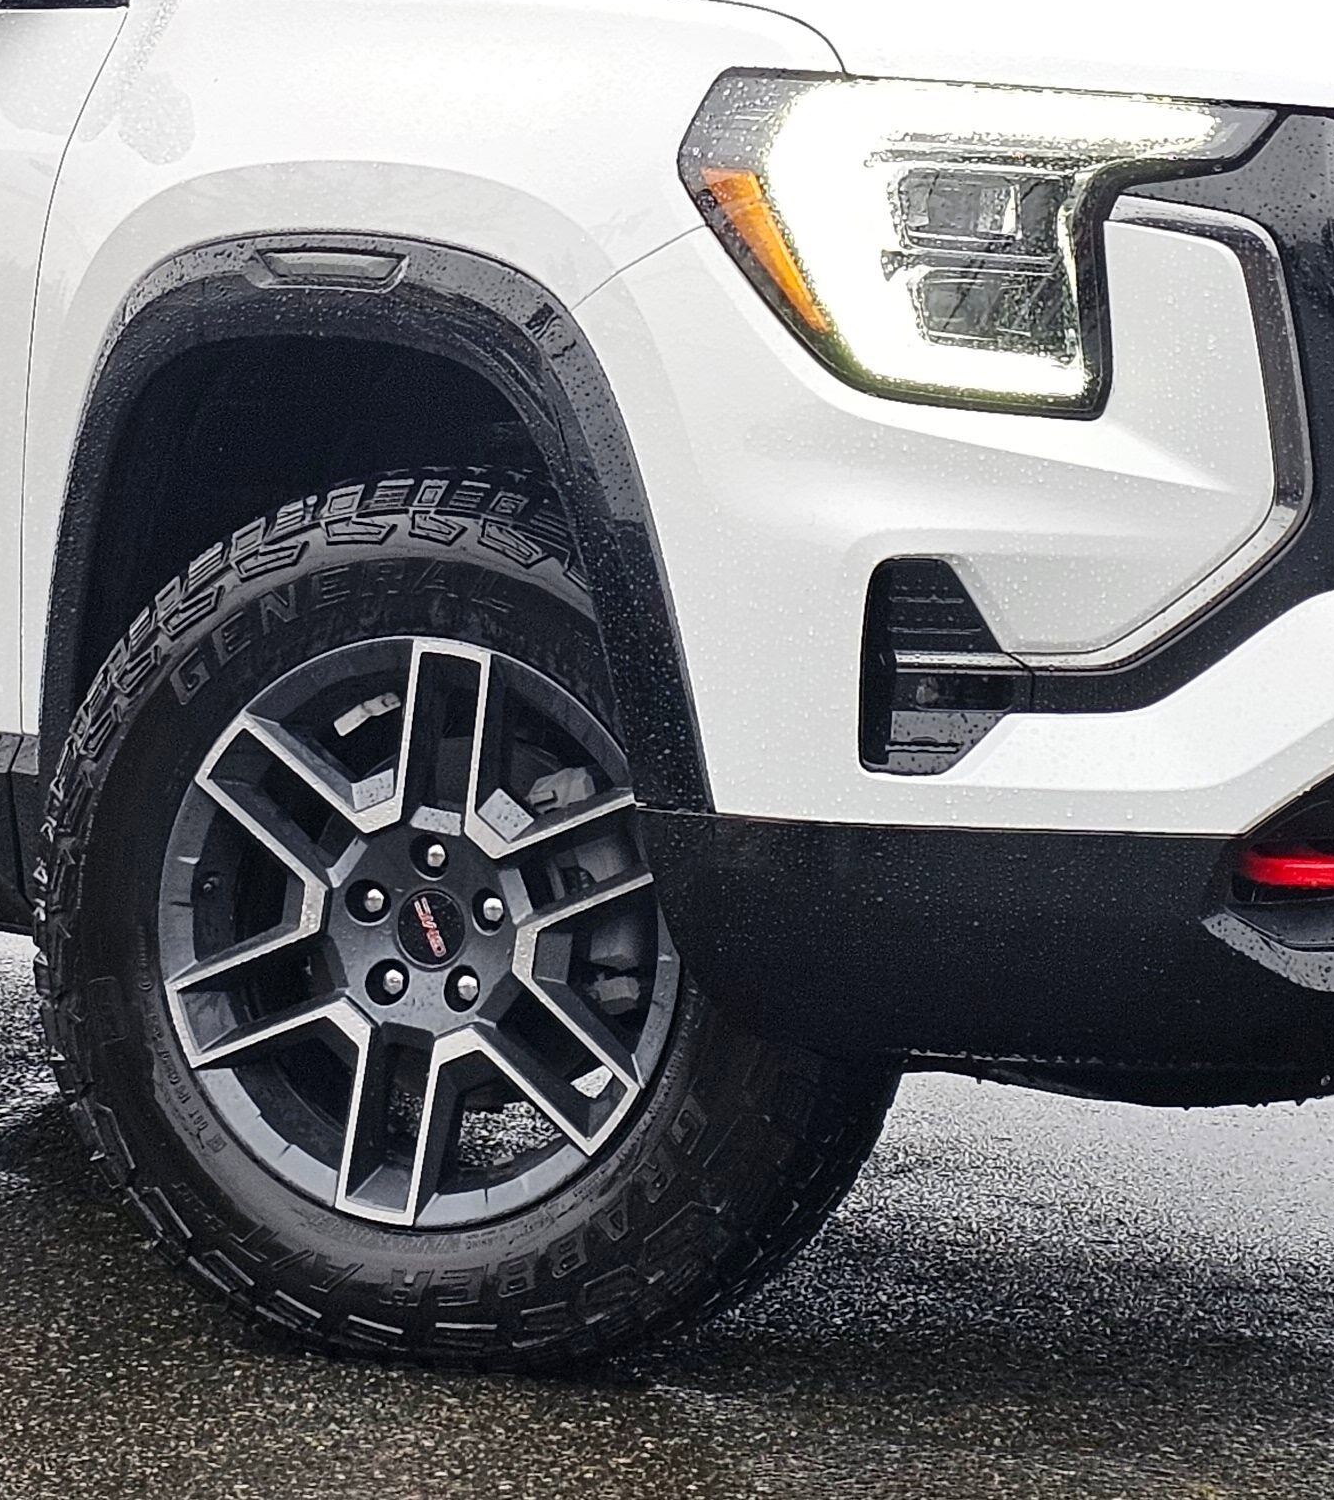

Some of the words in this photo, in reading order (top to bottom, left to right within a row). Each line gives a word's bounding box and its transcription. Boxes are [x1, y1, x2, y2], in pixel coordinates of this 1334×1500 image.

[168, 558, 515, 706] GENERAL
[413, 896, 447, 958] GMC
[378, 1093, 709, 1308] GRABBER
